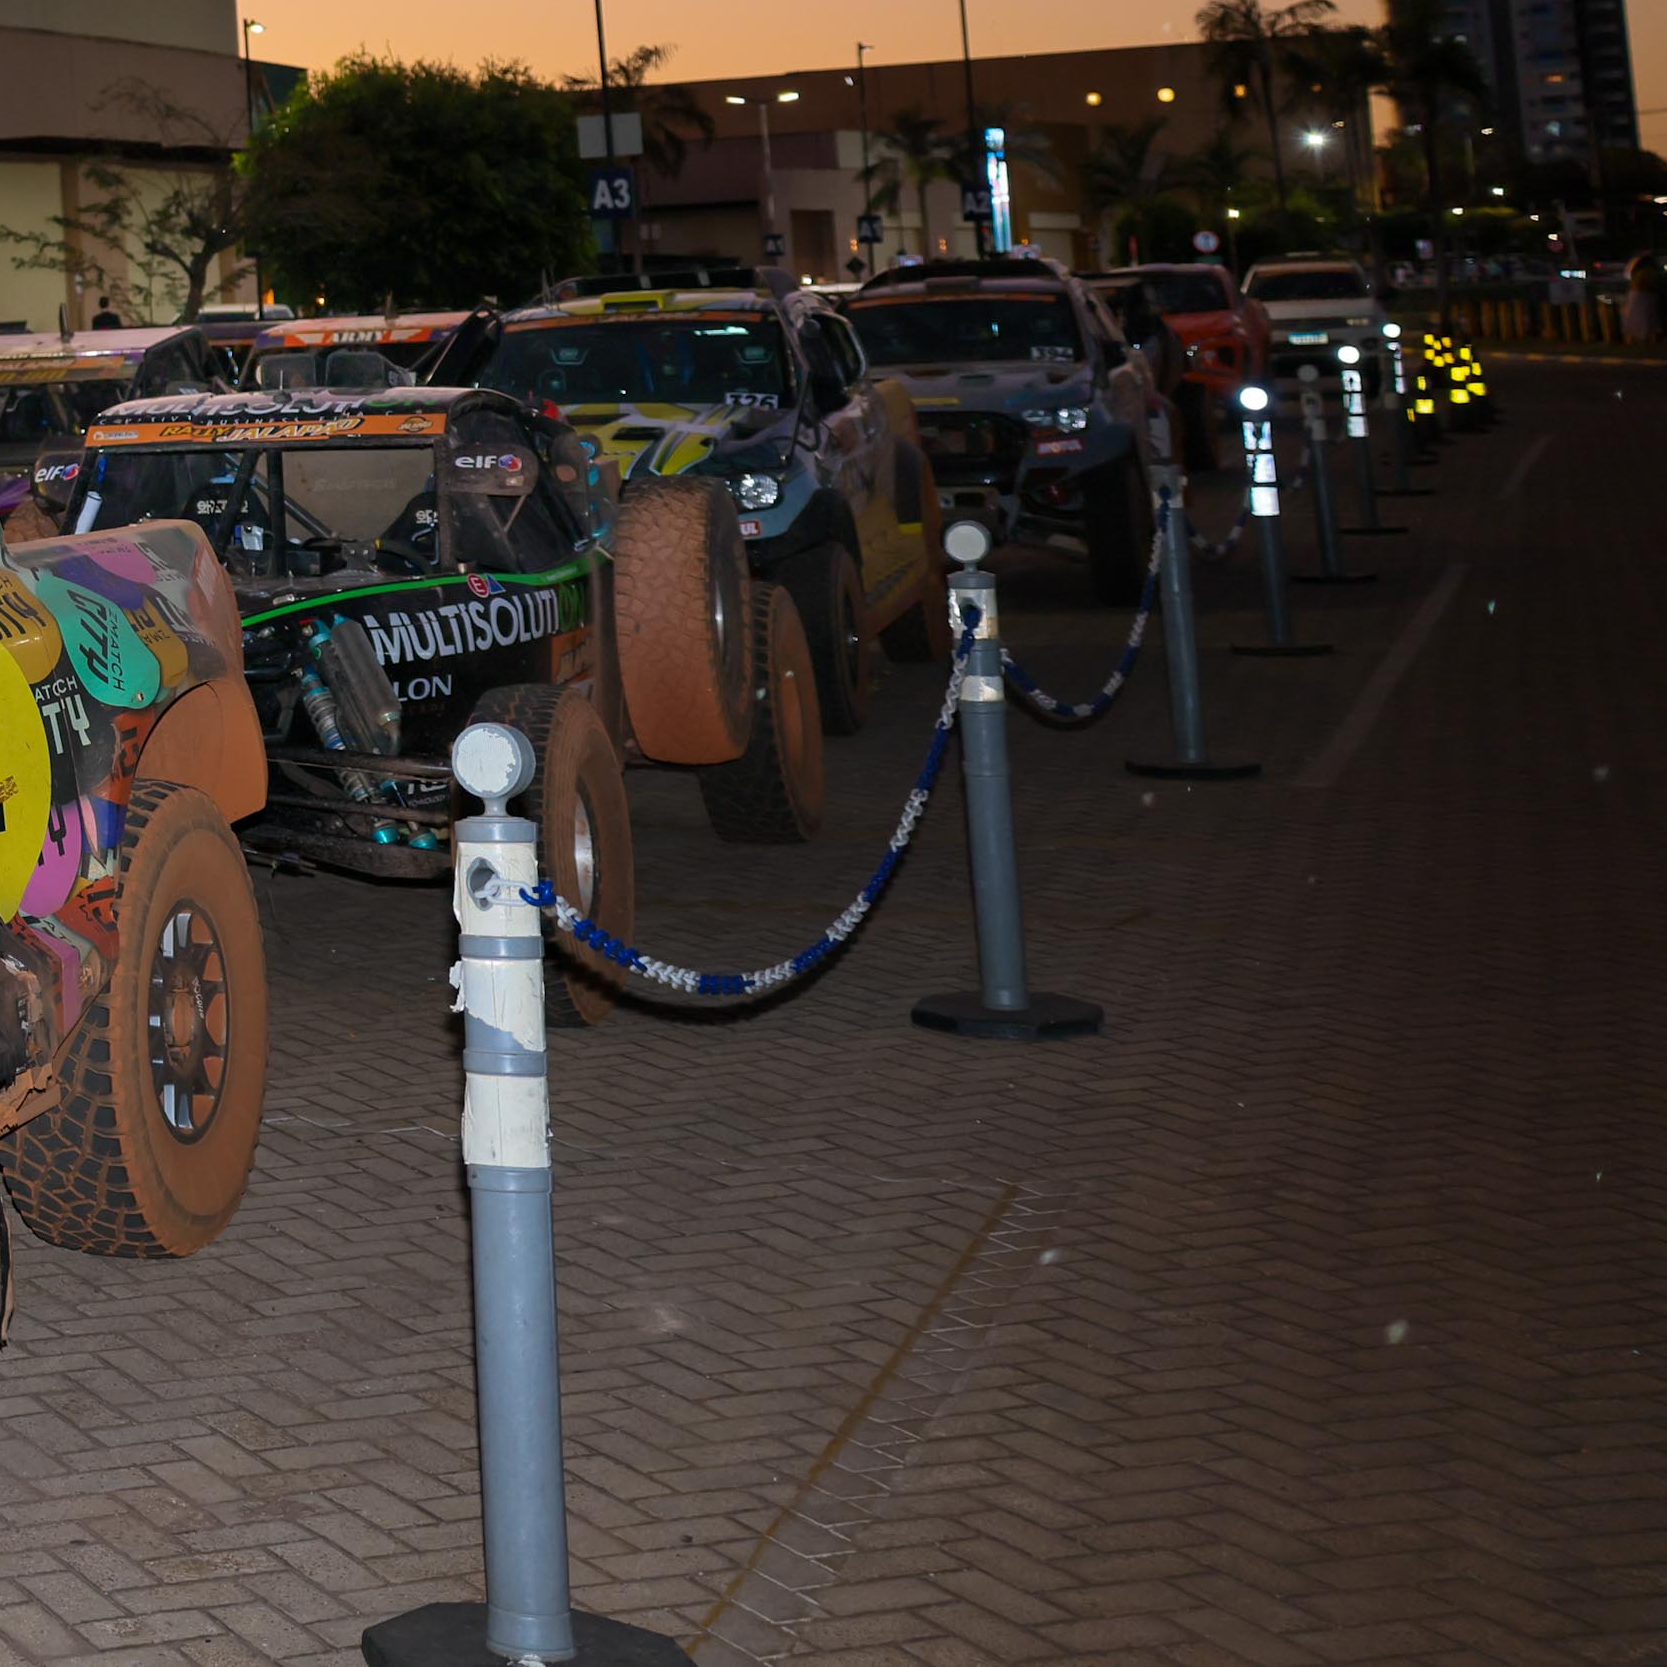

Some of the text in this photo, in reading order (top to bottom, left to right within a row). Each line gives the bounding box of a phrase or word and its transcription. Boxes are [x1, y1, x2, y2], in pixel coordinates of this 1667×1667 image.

[593, 179, 631, 210] A3
[455, 454, 497, 470] elf
[34, 465, 65, 483] elf
